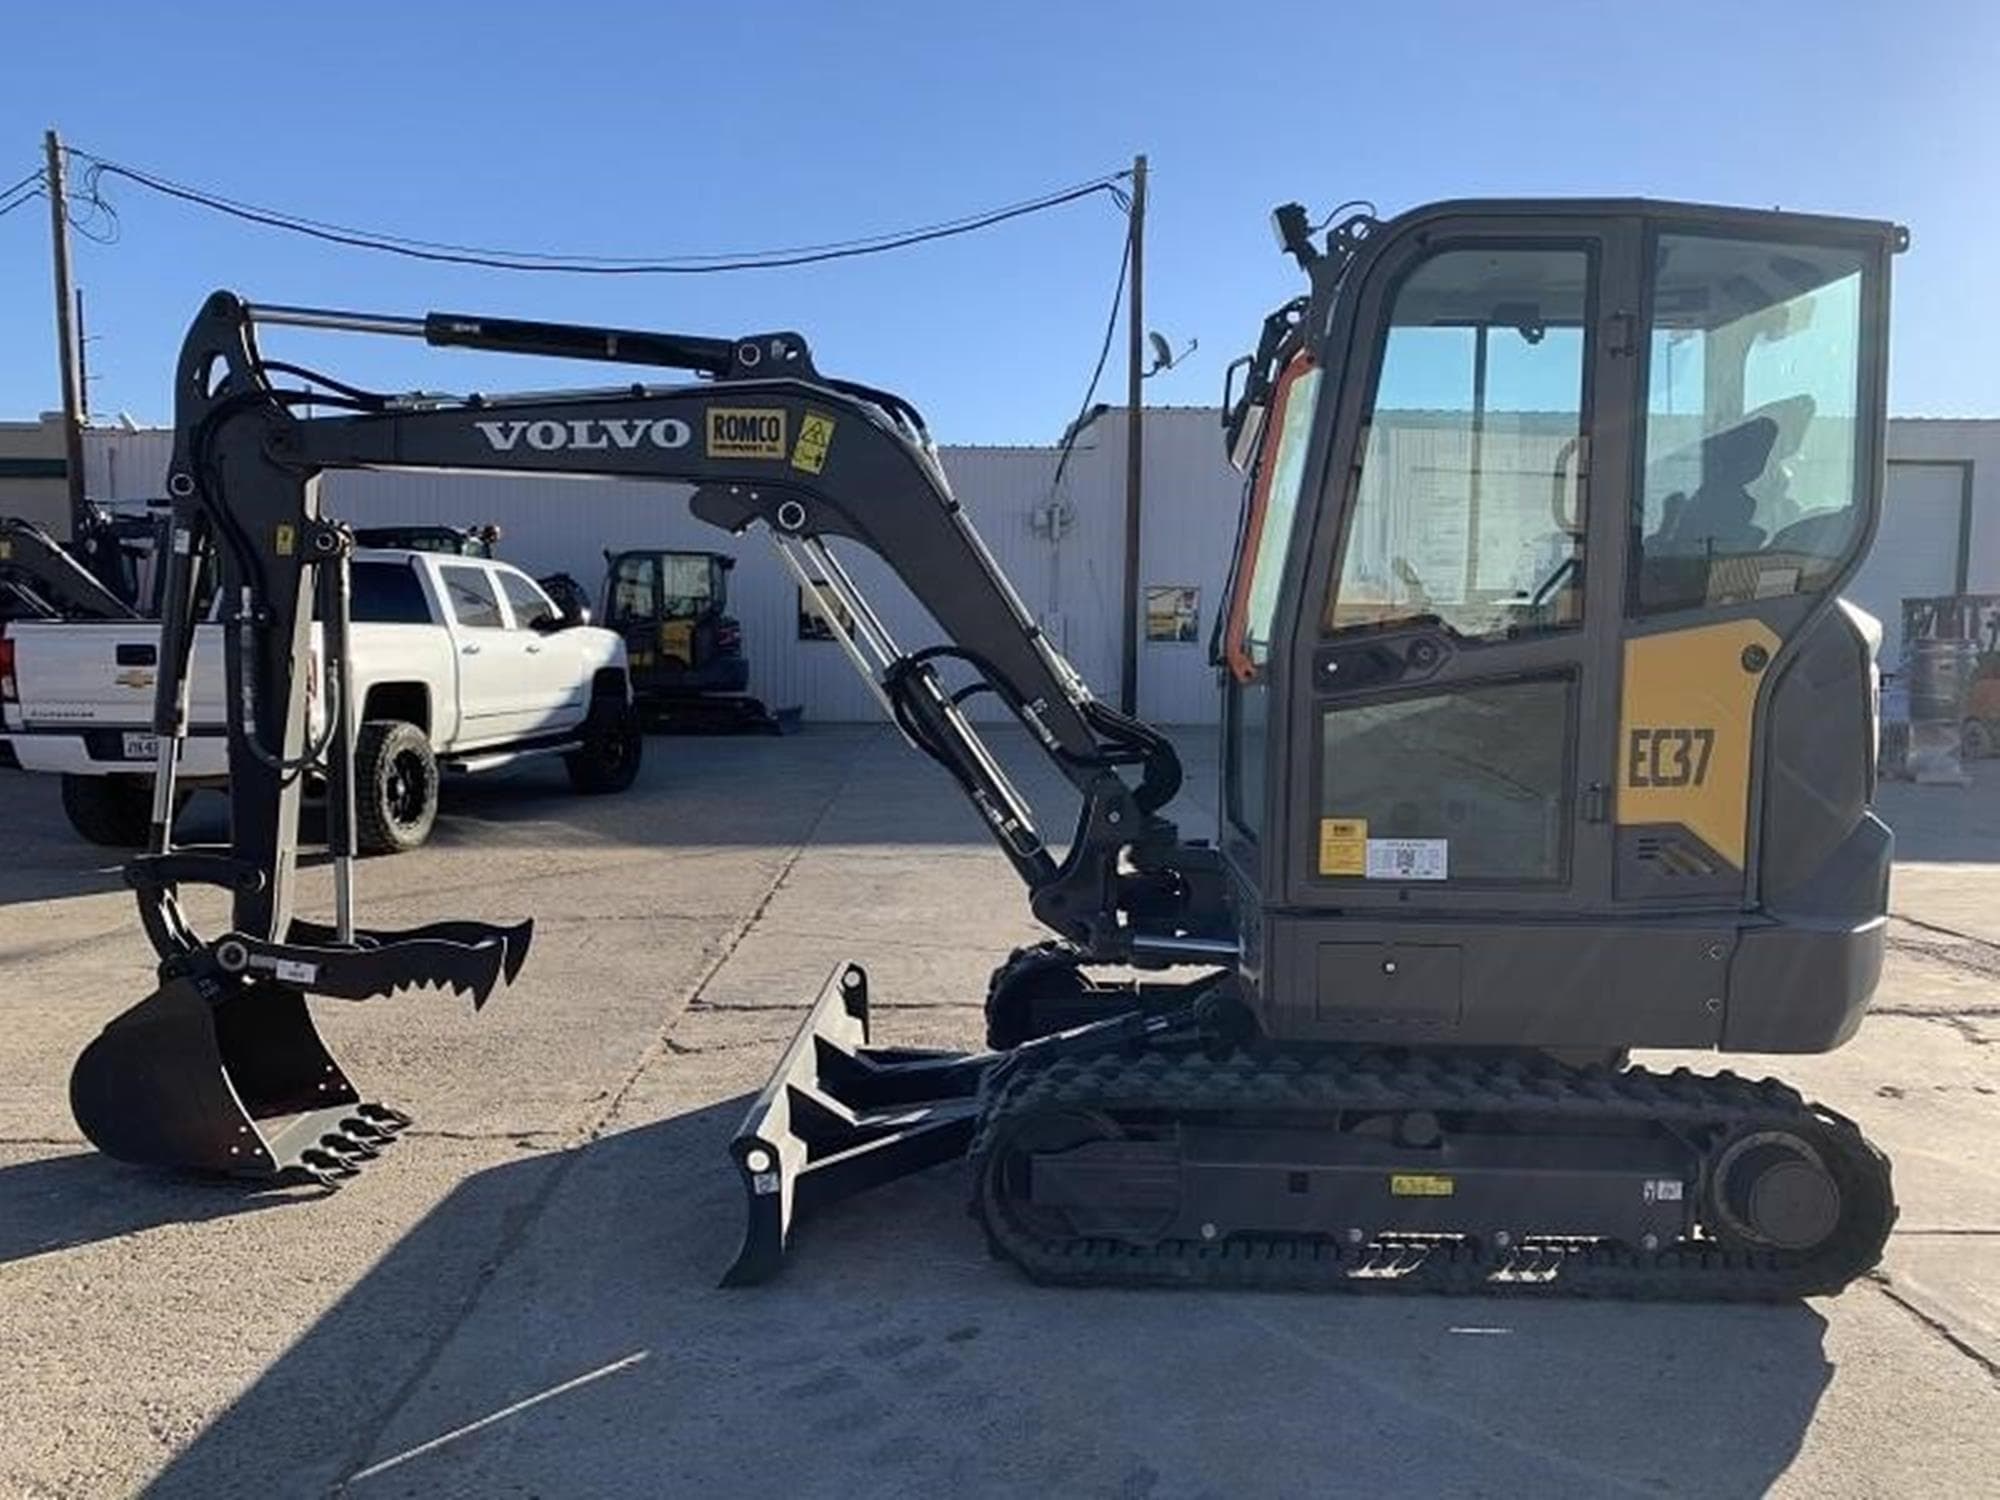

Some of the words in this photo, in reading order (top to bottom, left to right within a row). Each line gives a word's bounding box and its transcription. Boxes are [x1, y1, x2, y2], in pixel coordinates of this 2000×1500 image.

[475, 419, 691, 450] VOLVO
[713, 415, 780, 442] ROMCO
[1629, 729, 1714, 787] EC37
